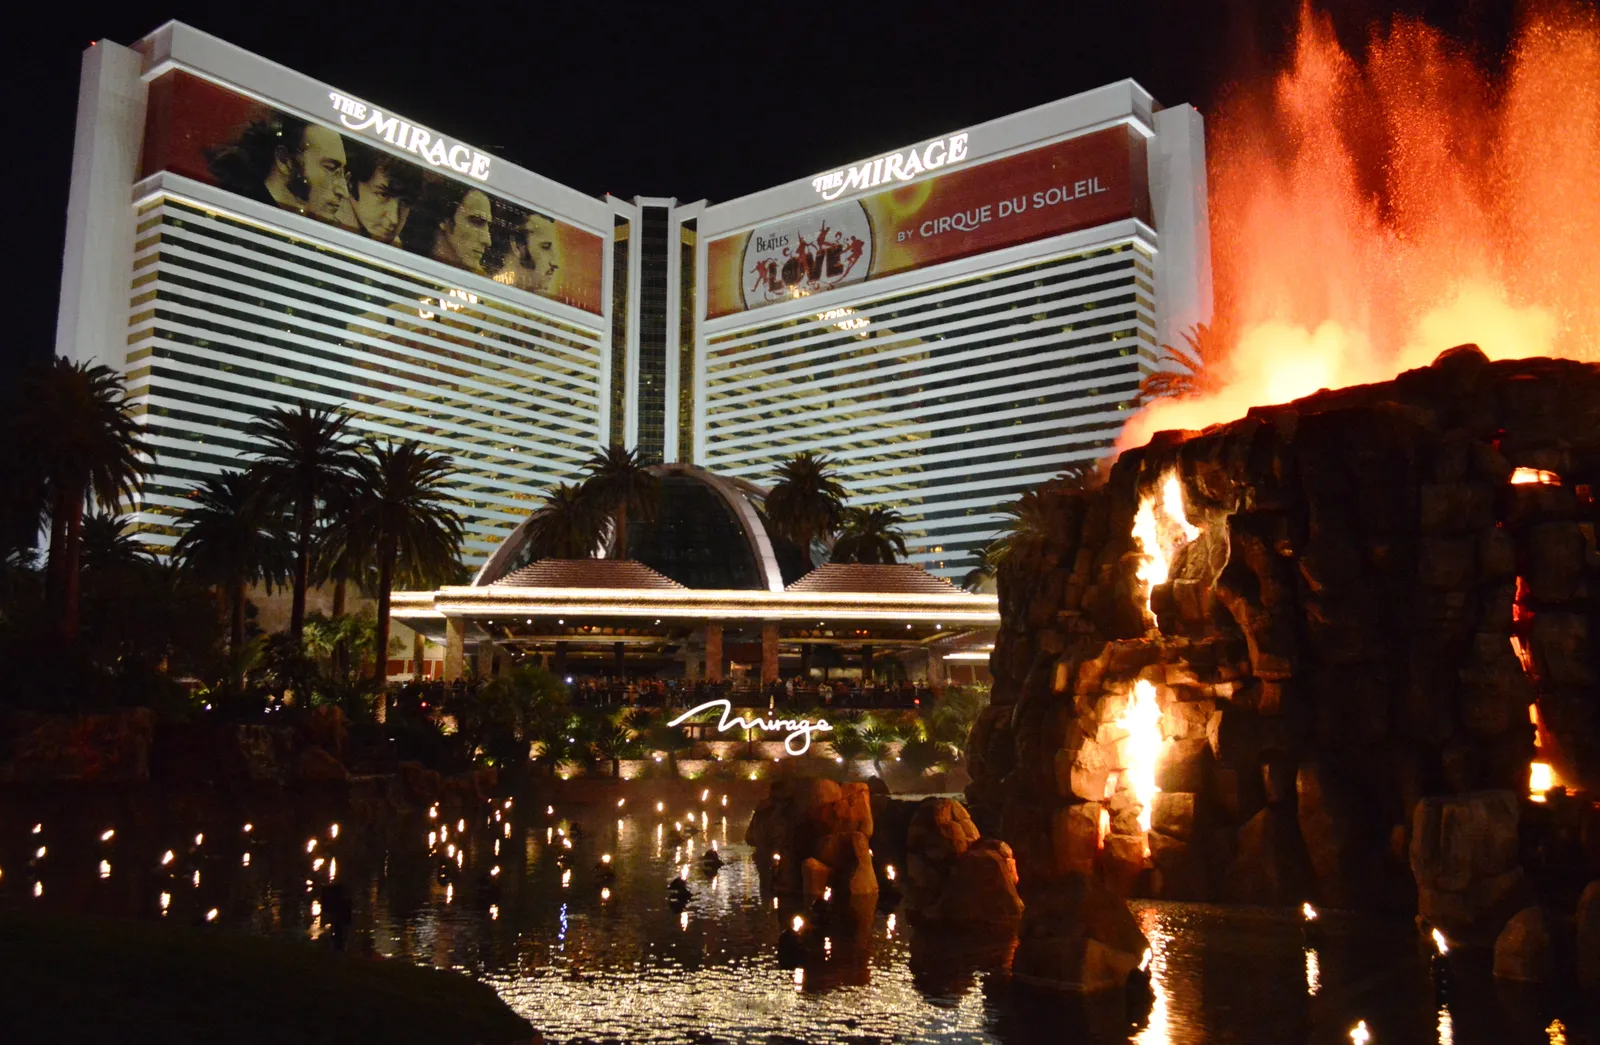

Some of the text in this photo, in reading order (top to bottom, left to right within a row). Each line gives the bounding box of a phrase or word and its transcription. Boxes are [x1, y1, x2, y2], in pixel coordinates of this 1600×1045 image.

[329, 92, 491, 182] THE MIRAGE
[812, 132, 969, 201] THE MIRAGE
[897, 229, 913, 242] BY
[919, 205, 992, 238] CIRQUE
[998, 195, 1027, 218] DU
[769, 243, 845, 292] LOVE
